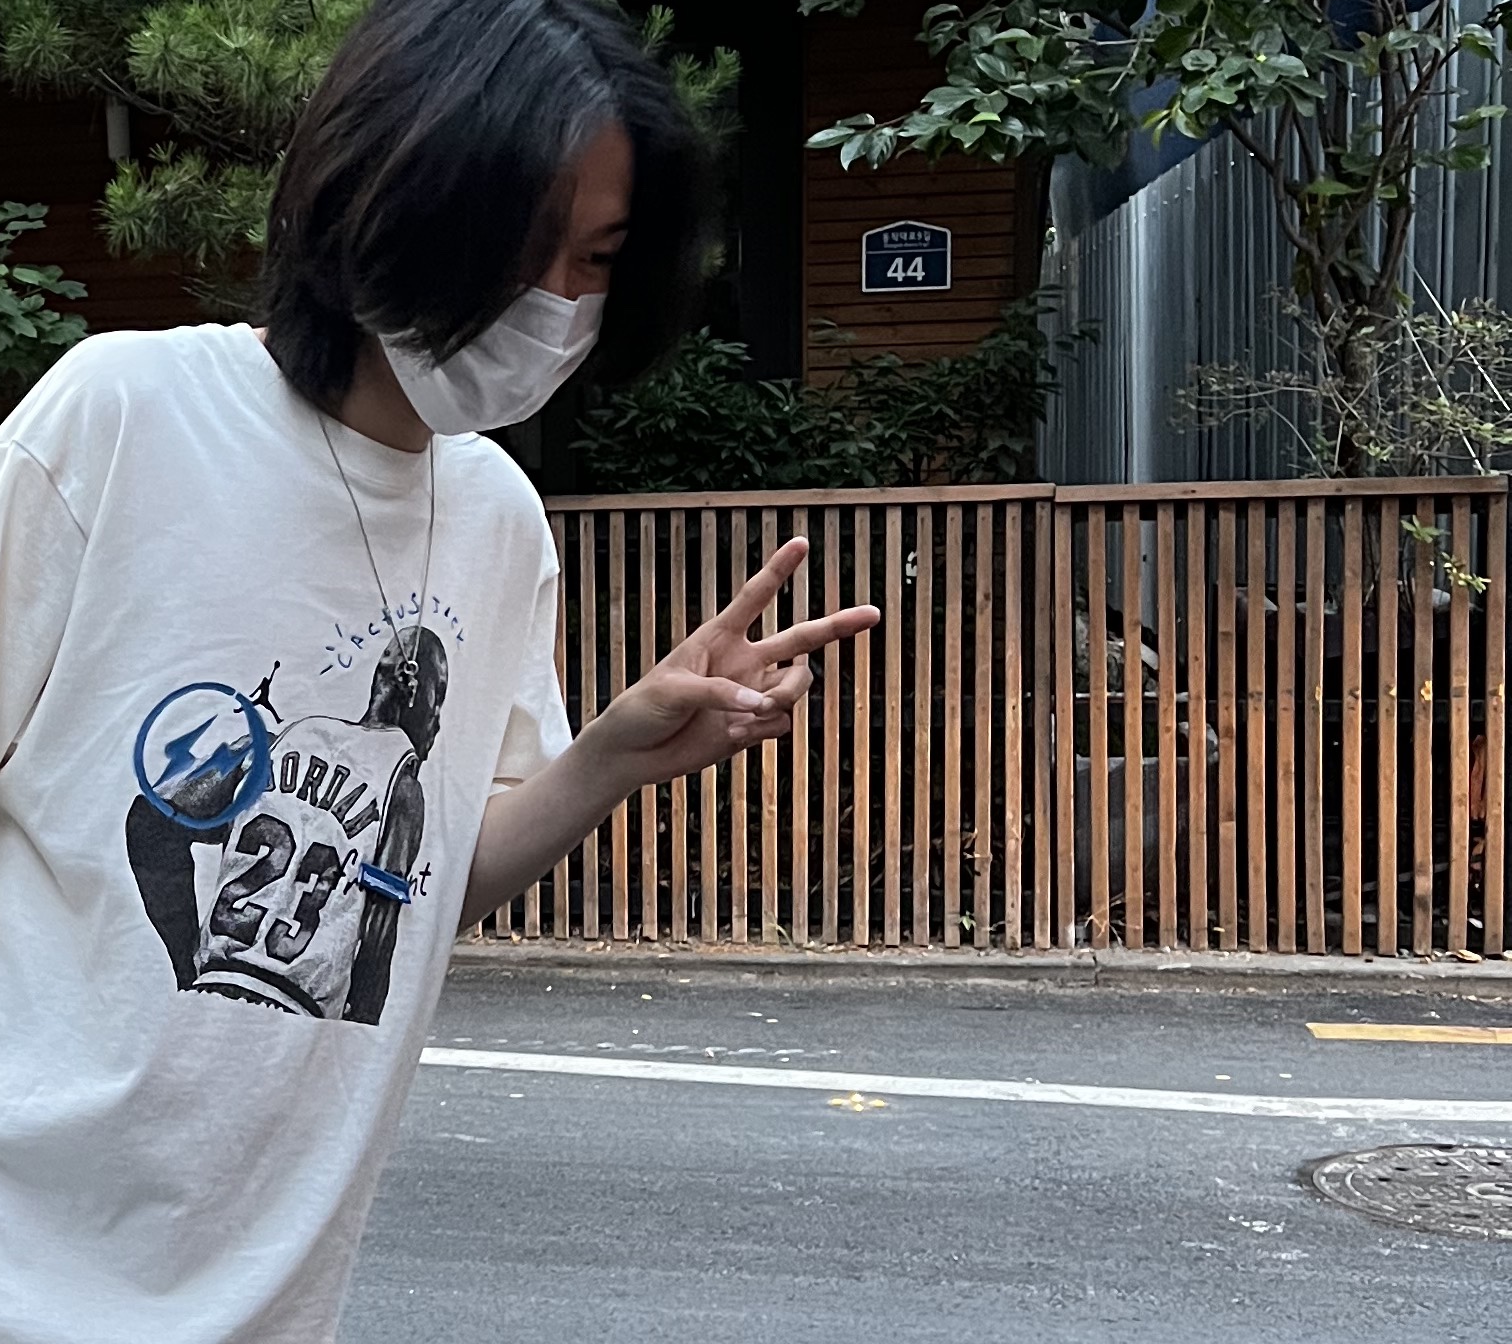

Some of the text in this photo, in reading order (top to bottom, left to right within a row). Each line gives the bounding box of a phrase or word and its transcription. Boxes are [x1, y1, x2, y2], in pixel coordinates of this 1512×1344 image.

[886, 256, 926, 282] 44
[265, 751, 380, 840] ORDAN
[209, 812, 342, 965] 23
